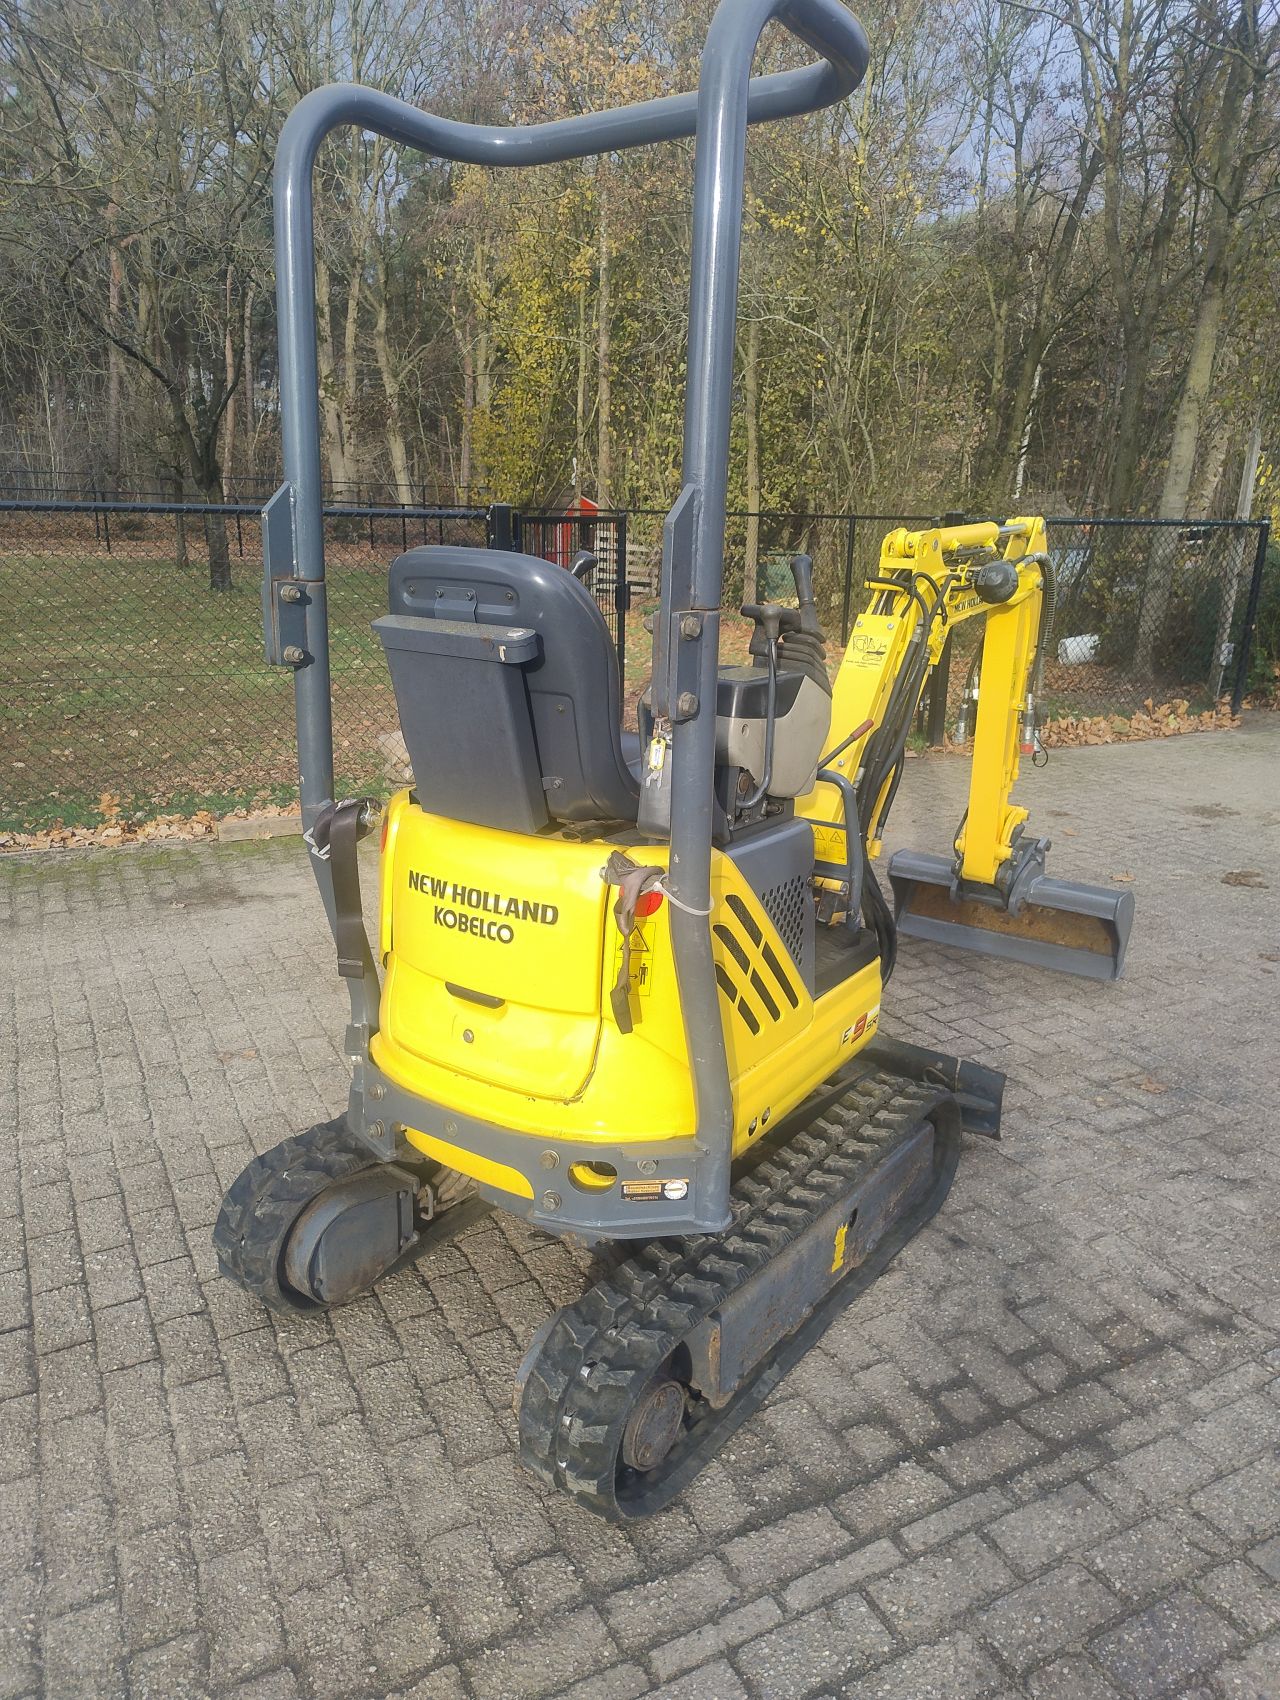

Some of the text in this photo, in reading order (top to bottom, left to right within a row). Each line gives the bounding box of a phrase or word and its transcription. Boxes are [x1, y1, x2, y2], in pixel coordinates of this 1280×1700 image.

[408, 869, 559, 926] NEW HOLLAND
[434, 905, 515, 945] KOBELCO
